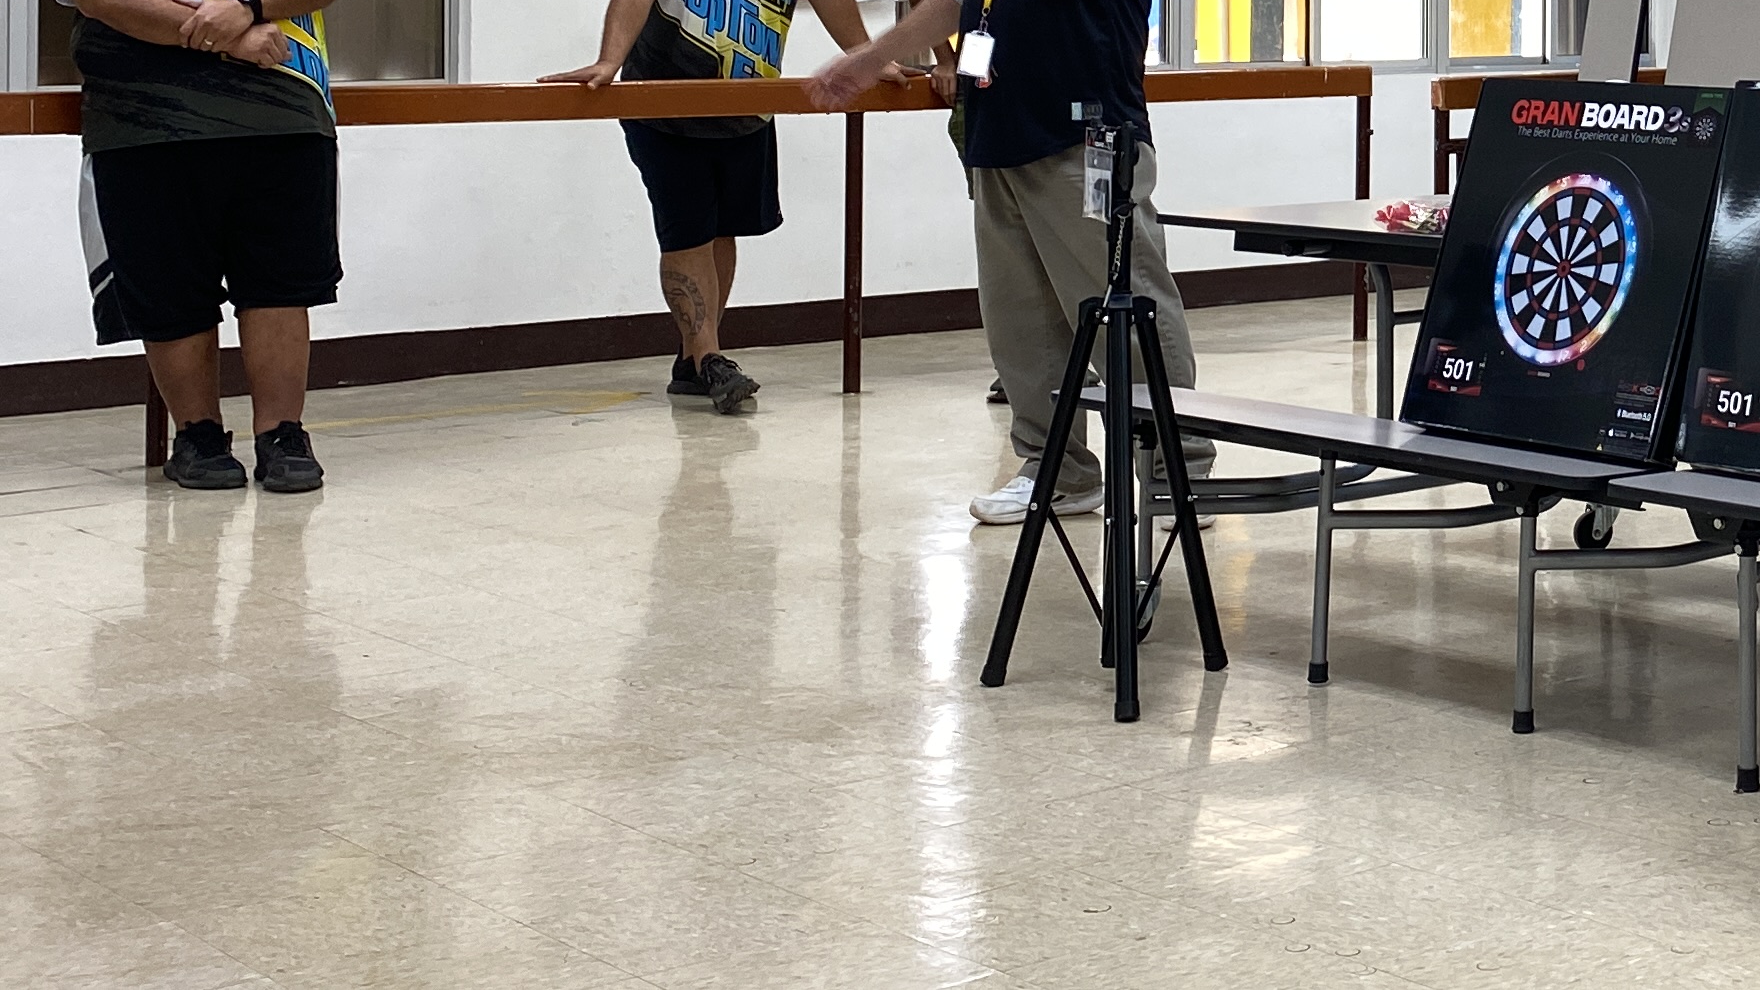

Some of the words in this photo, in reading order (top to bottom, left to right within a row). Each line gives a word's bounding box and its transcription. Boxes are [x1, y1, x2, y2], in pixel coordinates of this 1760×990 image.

[1517, 126, 1533, 137] The
[1533, 127, 1550, 139] Best
[1551, 128, 1573, 140] Darts
[1574, 130, 1619, 143] Experience
[1619, 133, 1629, 143] at
[1630, 132, 1650, 144] Your
[1651, 134, 1678, 146] Home
[1579, 340, 1588, 352] 2
[1442, 357, 1474, 381] 501
[1717, 389, 1753, 417] 501
